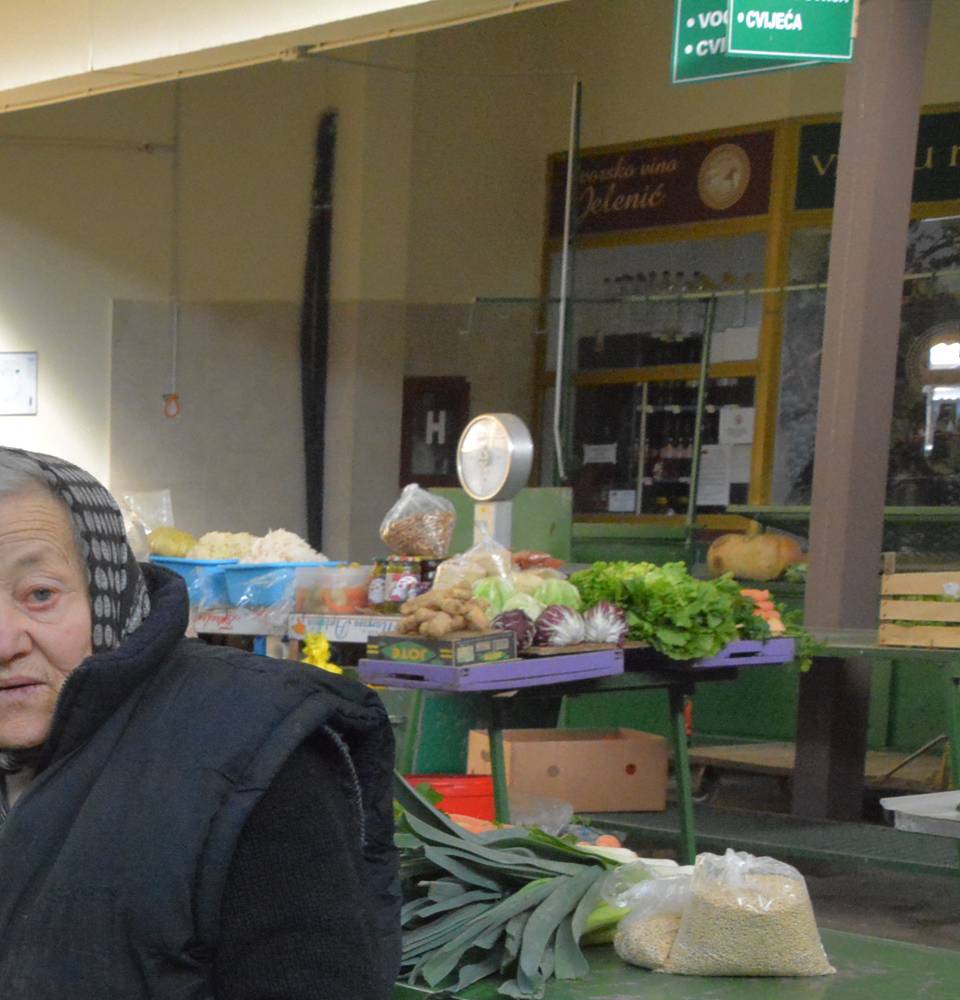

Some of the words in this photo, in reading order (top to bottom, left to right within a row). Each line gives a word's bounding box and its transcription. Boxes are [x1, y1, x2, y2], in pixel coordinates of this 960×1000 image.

[746, 8, 803, 31] CVIJEĆA
[696, 37, 727, 57] CVI
[578, 183, 667, 224] Jelenić
[426, 410, 446, 444] H
